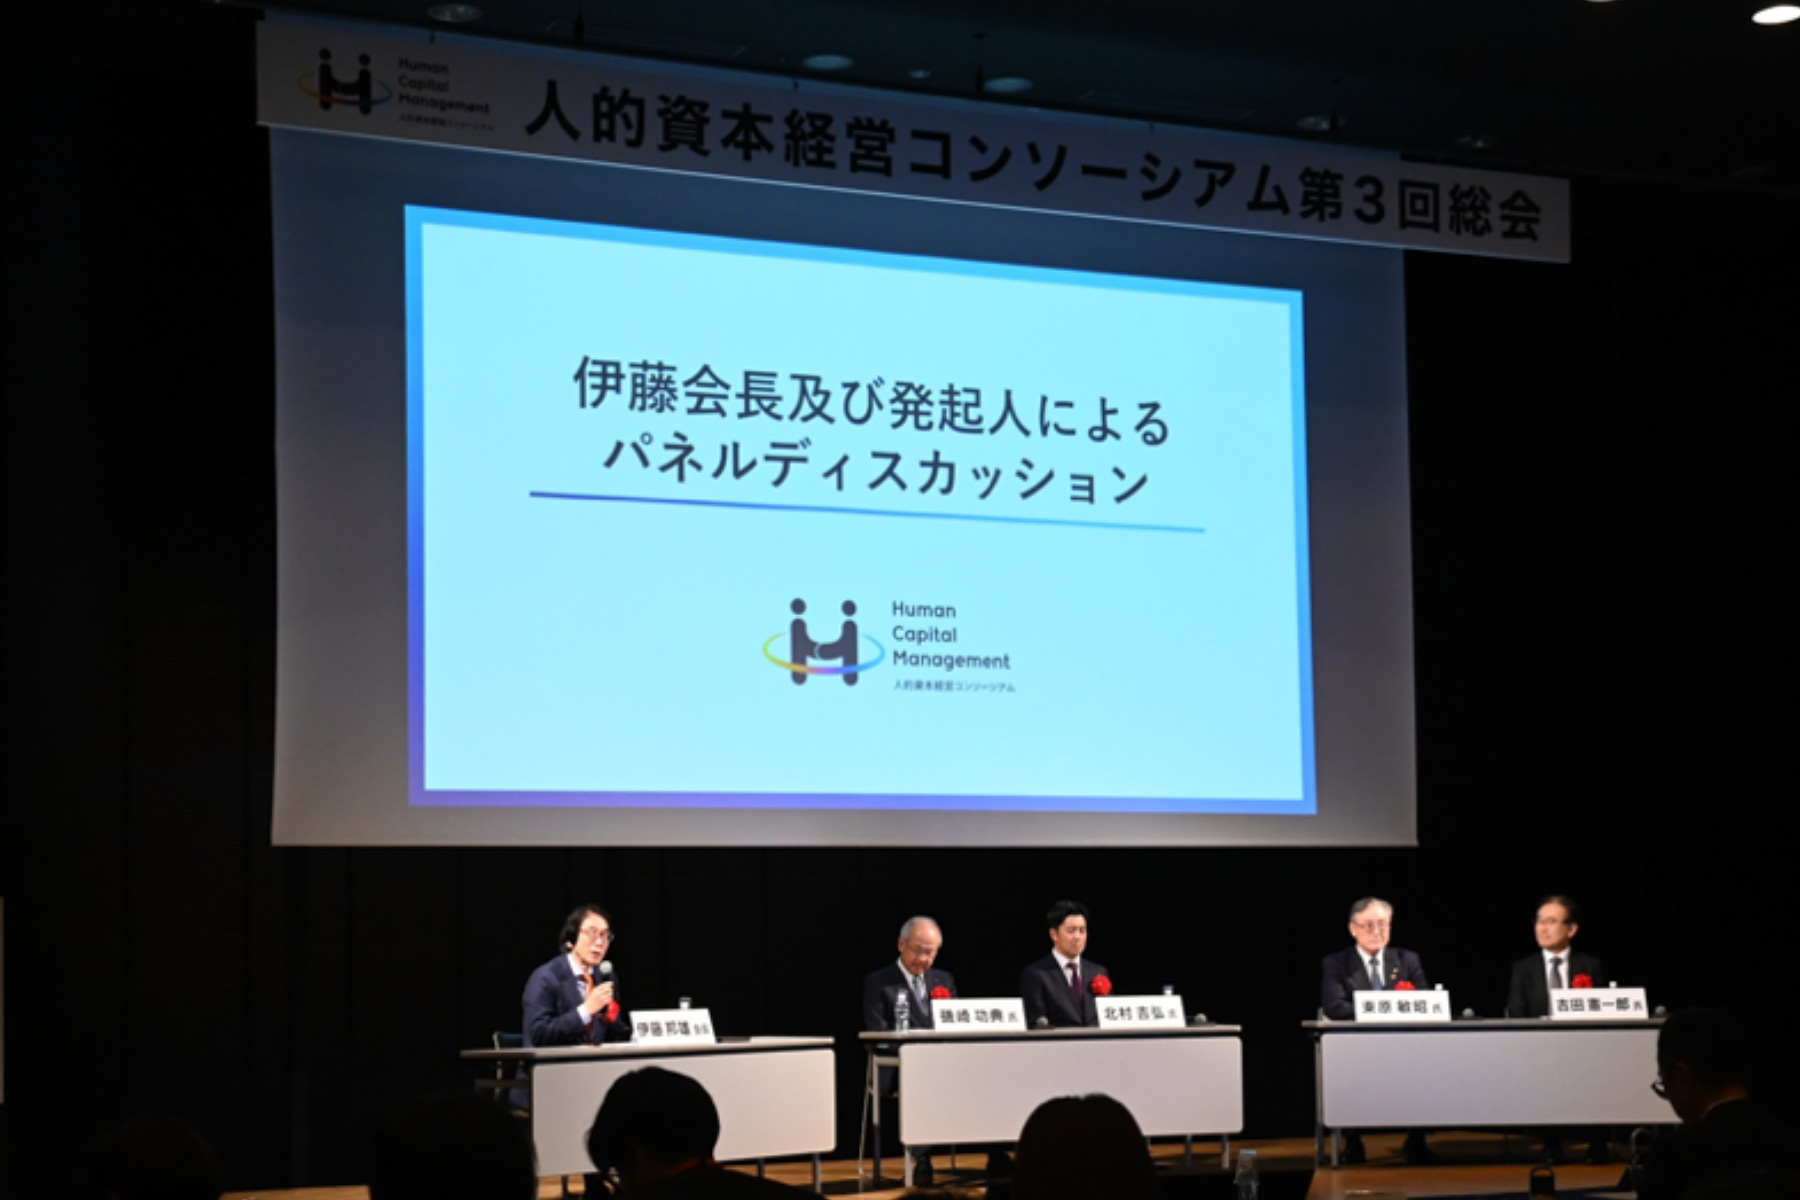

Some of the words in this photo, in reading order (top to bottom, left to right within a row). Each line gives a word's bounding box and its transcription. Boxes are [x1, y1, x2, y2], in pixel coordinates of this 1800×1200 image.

[398, 58, 449, 75] Human
[398, 75, 449, 93] Capital
[398, 93, 489, 115] Management
[573, 355, 1169, 447] 伊藤会長及び発起人による
[603, 431, 1148, 505] パネルディスカッション
[892, 600, 956, 618] Human
[892, 625, 957, 645] Capital
[893, 650, 1011, 672] Management
